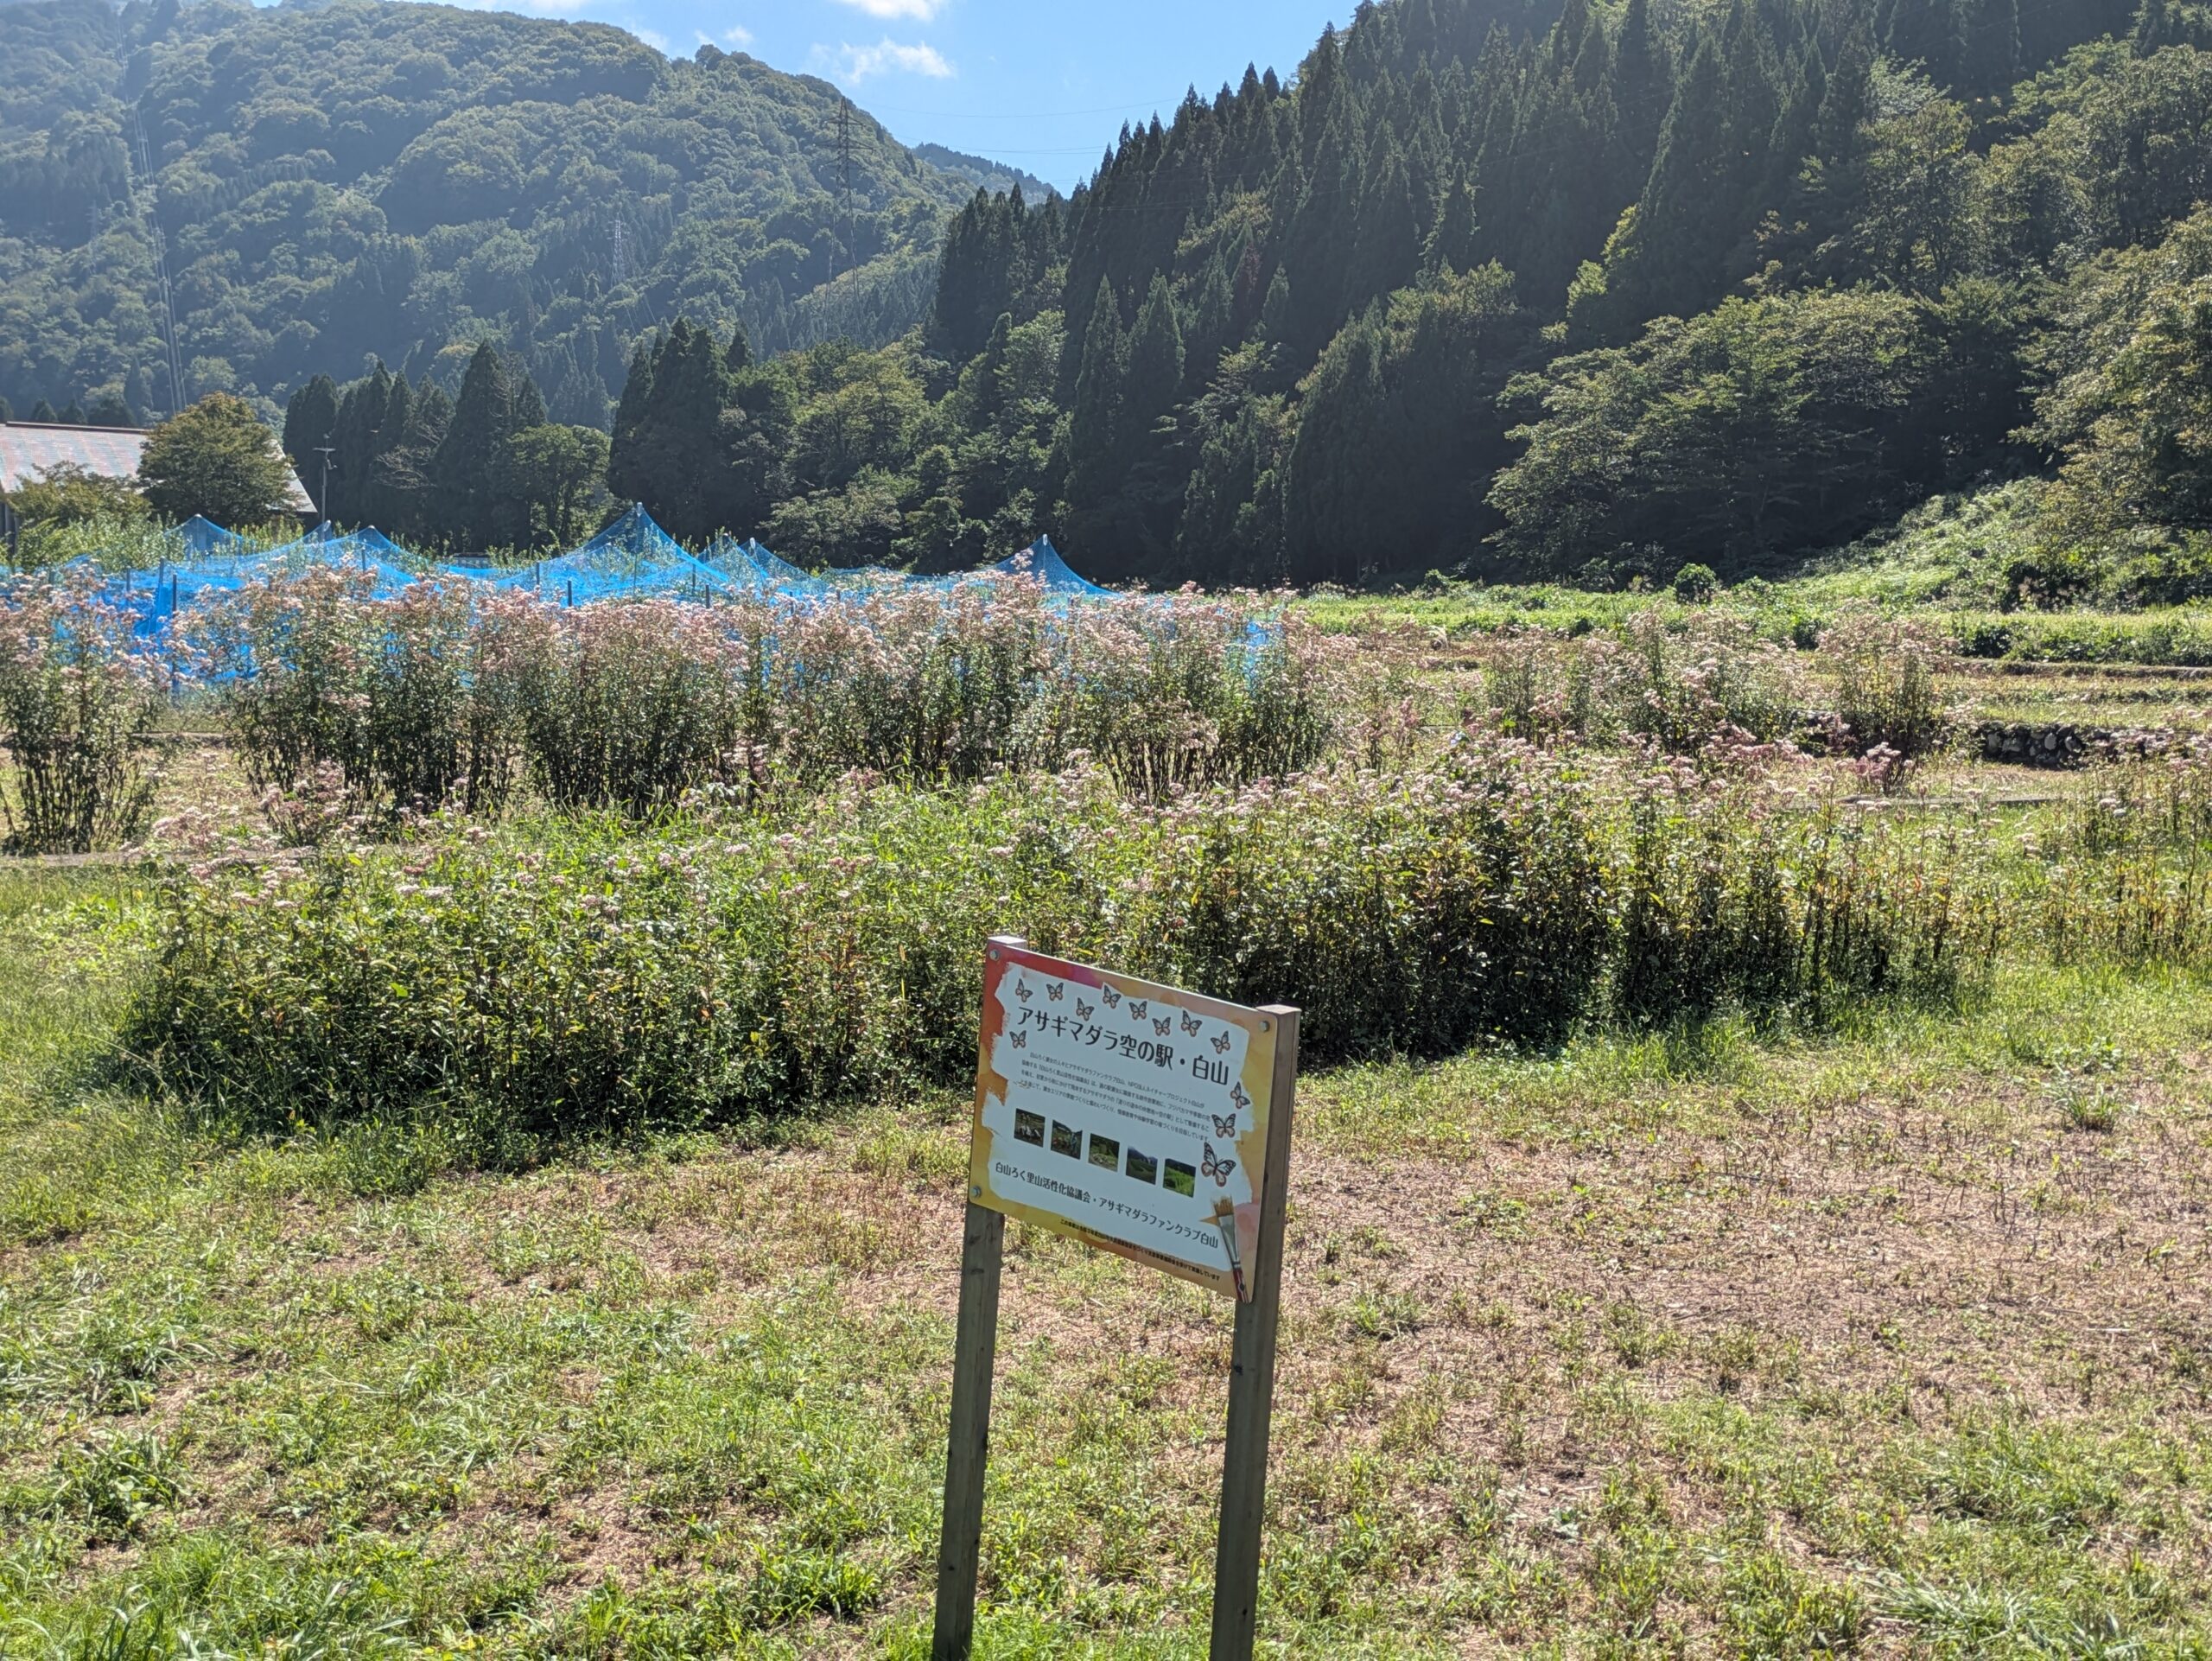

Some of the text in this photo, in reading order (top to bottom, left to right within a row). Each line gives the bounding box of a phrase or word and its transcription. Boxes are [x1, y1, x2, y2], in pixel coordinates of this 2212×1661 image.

[1018, 1007, 1229, 1085] アサギマダラ空の駅・白山
[996, 1162, 1217, 1248] 白山ろく里山活性化協議会・アサギマダラファンクラブ白山
